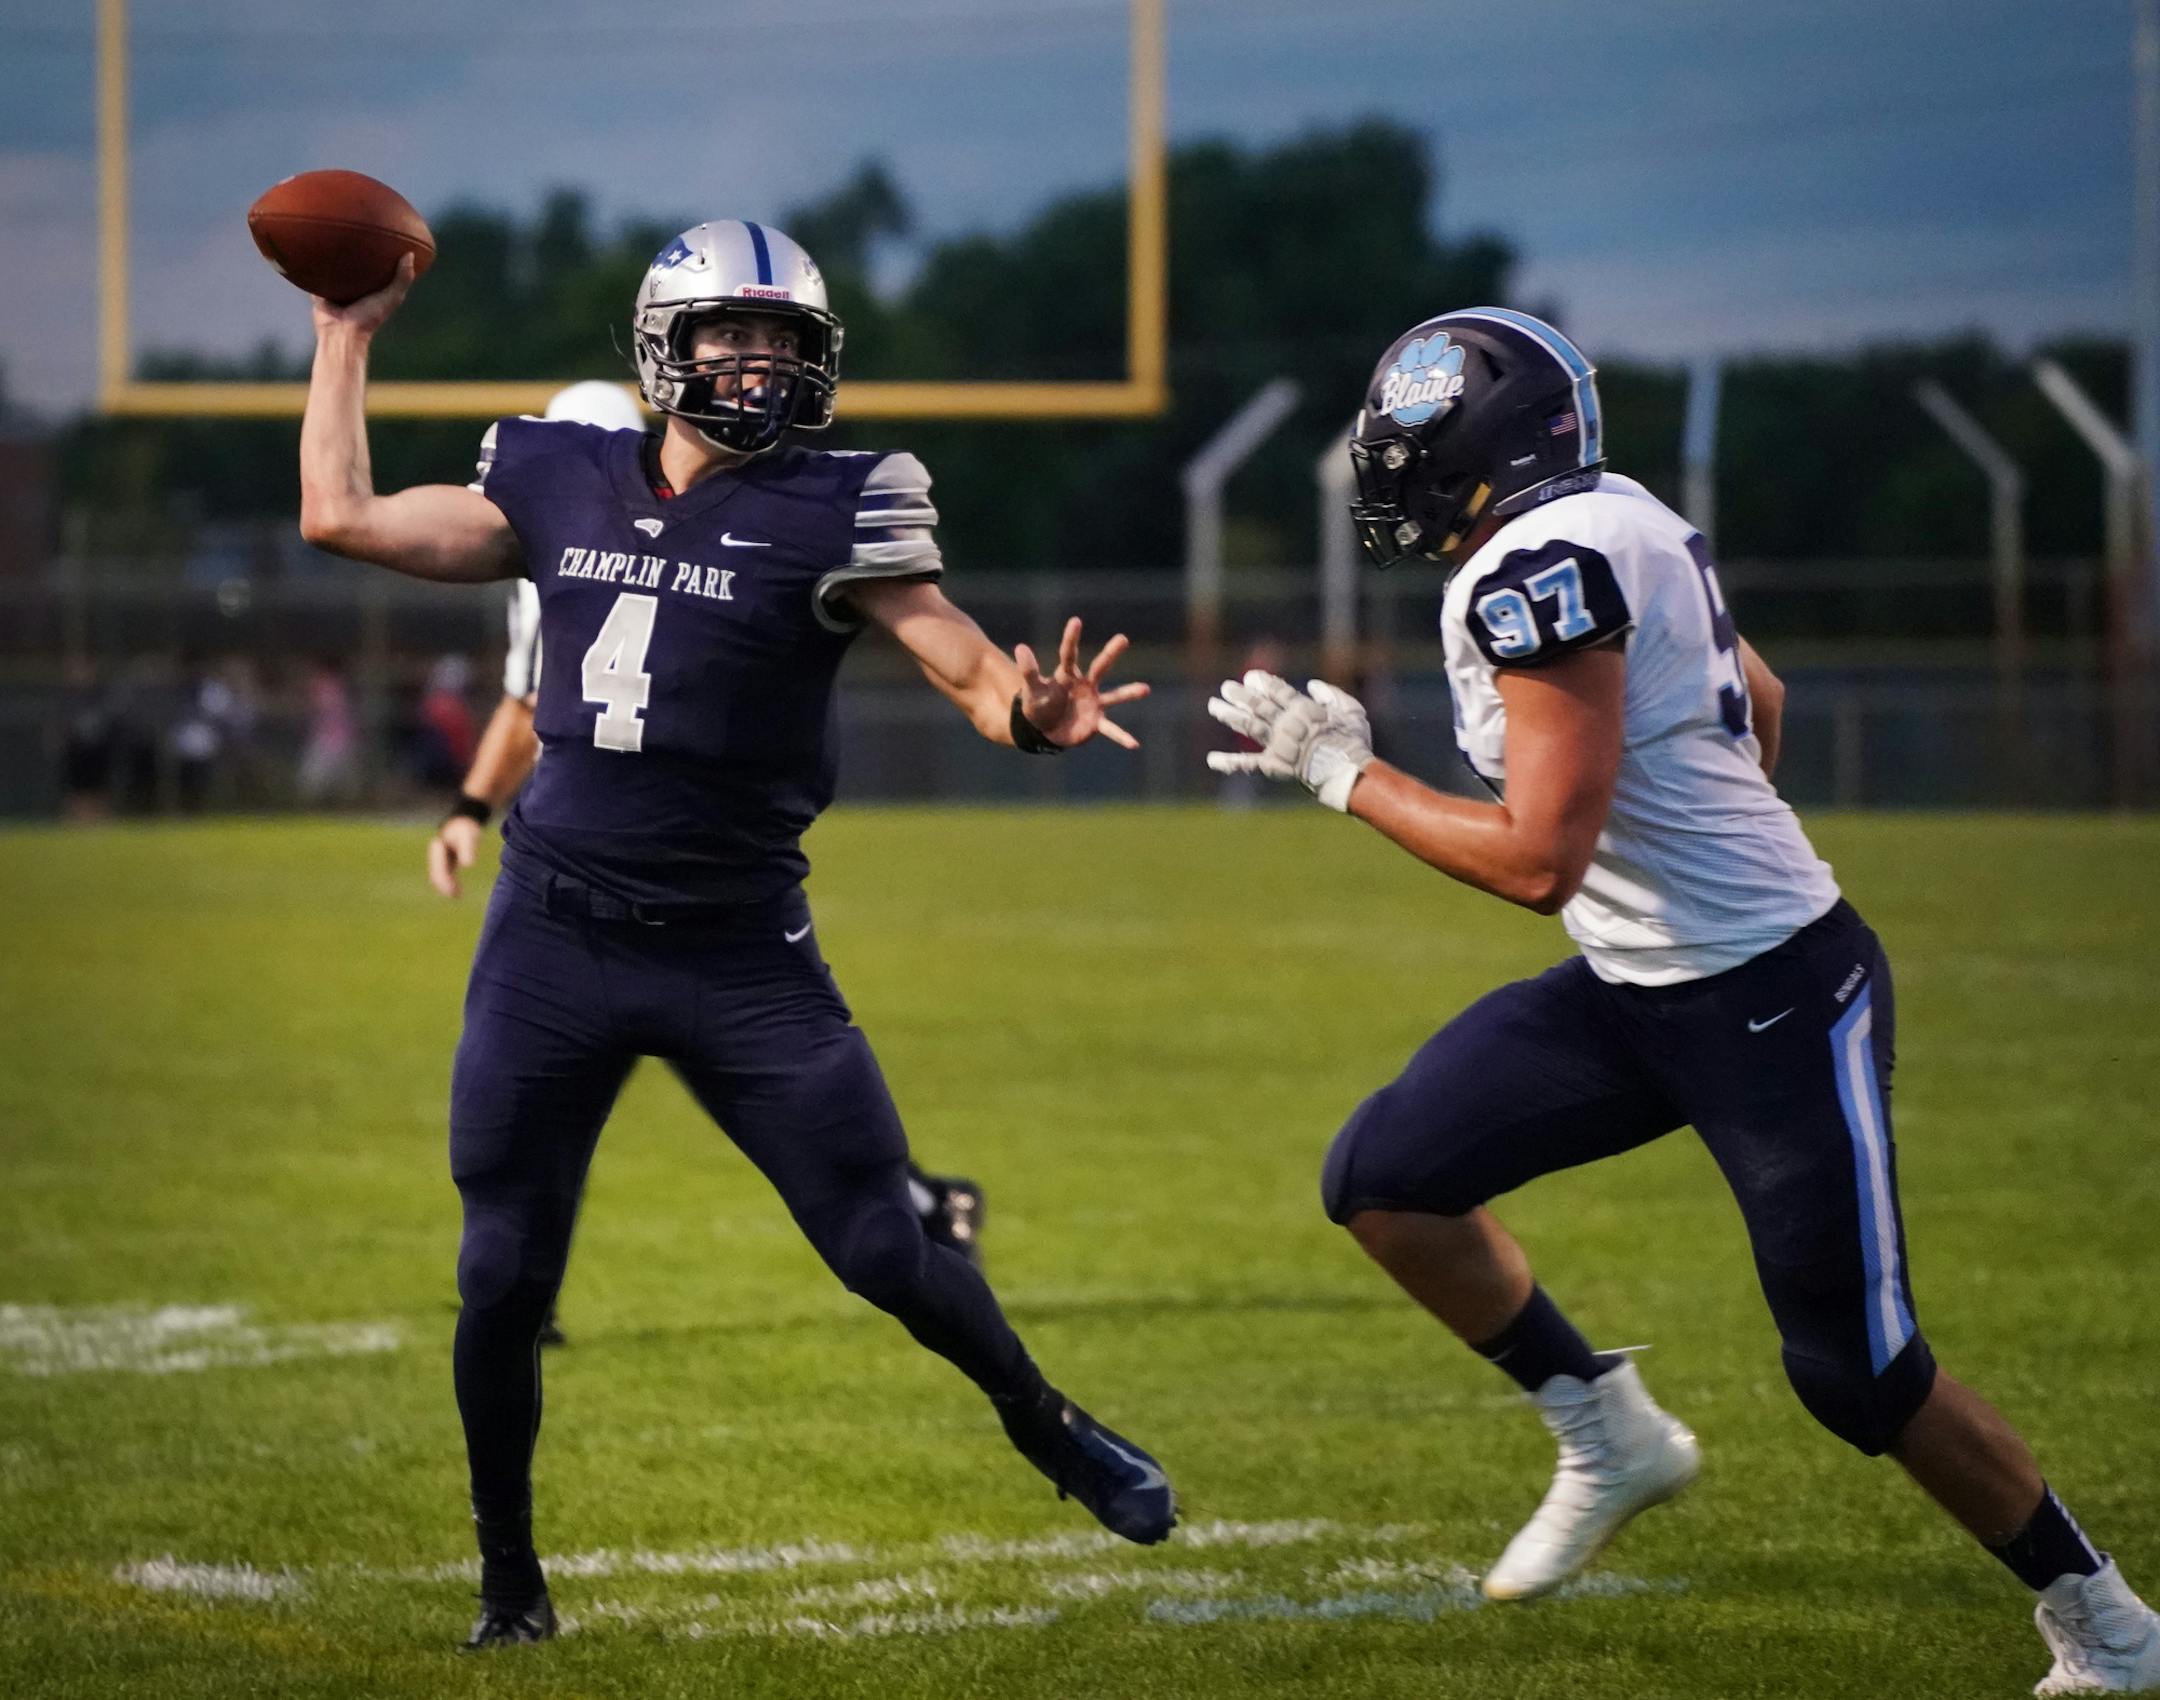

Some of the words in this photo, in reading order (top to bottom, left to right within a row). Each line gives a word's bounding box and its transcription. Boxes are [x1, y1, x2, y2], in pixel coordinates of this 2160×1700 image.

[1379, 374, 1464, 415] Blaine
[558, 547, 666, 588] CHAMPLIN
[671, 562, 736, 600] PARK
[1475, 557, 1596, 658] 97
[582, 592, 658, 752] 4
